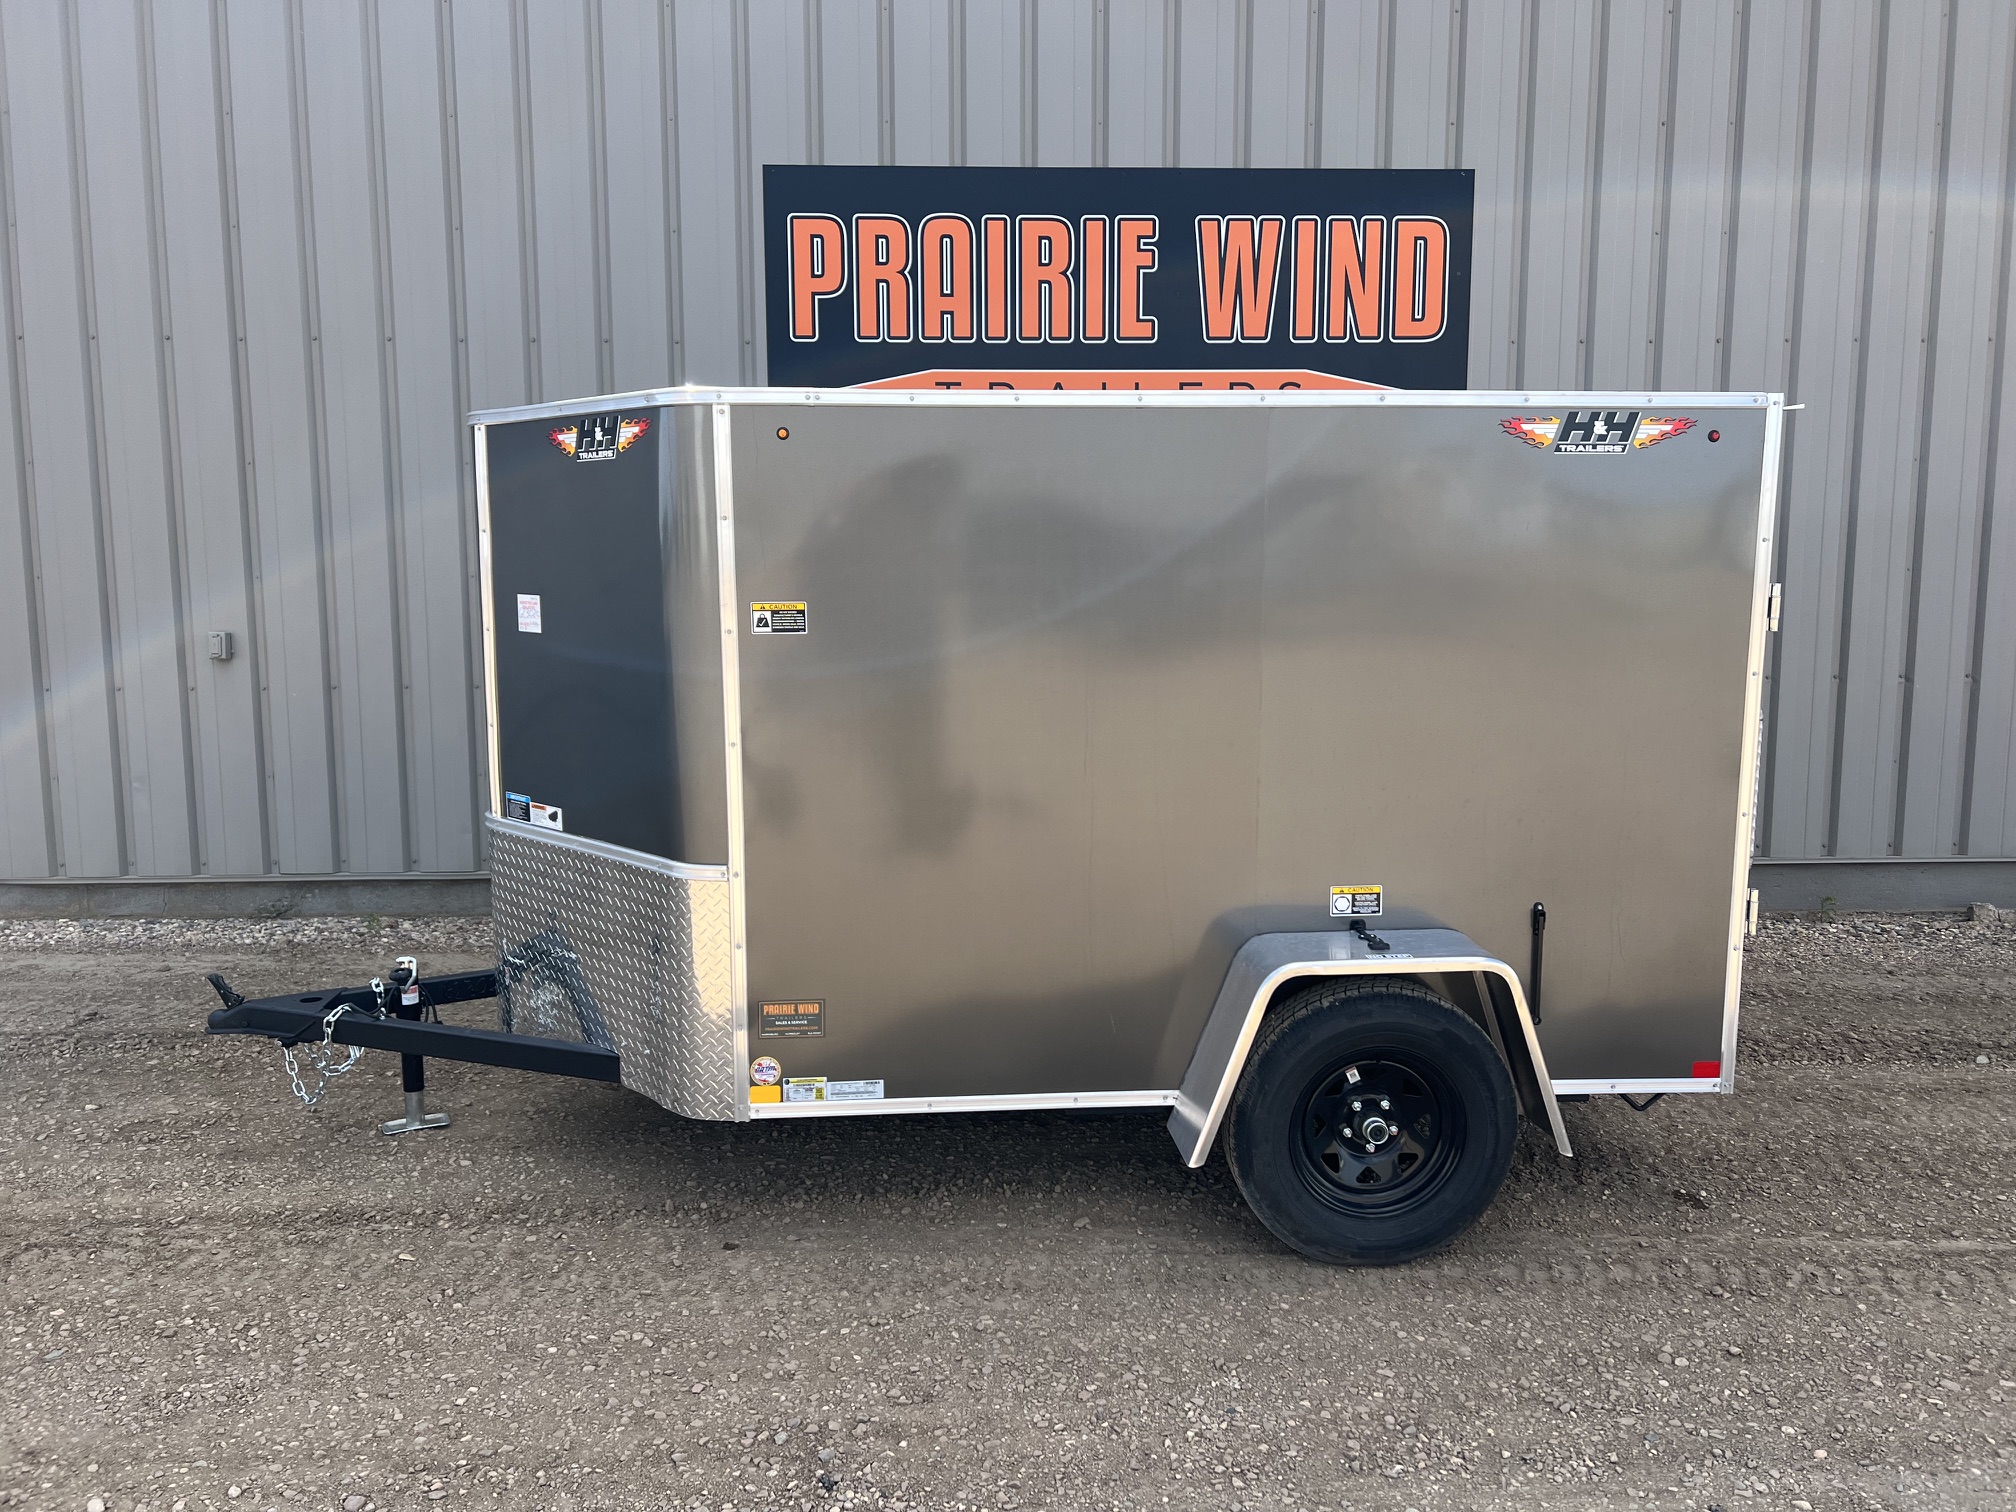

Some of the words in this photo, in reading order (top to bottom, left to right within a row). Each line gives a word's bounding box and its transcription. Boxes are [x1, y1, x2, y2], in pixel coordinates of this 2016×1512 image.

[787, 213, 1160, 343] PRAIRIE
[1194, 213, 1450, 343] WIND
[577, 415, 621, 451] H&H
[1557, 411, 1642, 444] H&H
[578, 450, 614, 459] TRAILERS
[1559, 444, 1625, 453] TRAILERS
[763, 1004, 796, 1015] PRAIRIE
[797, 1003, 819, 1014] WIND
